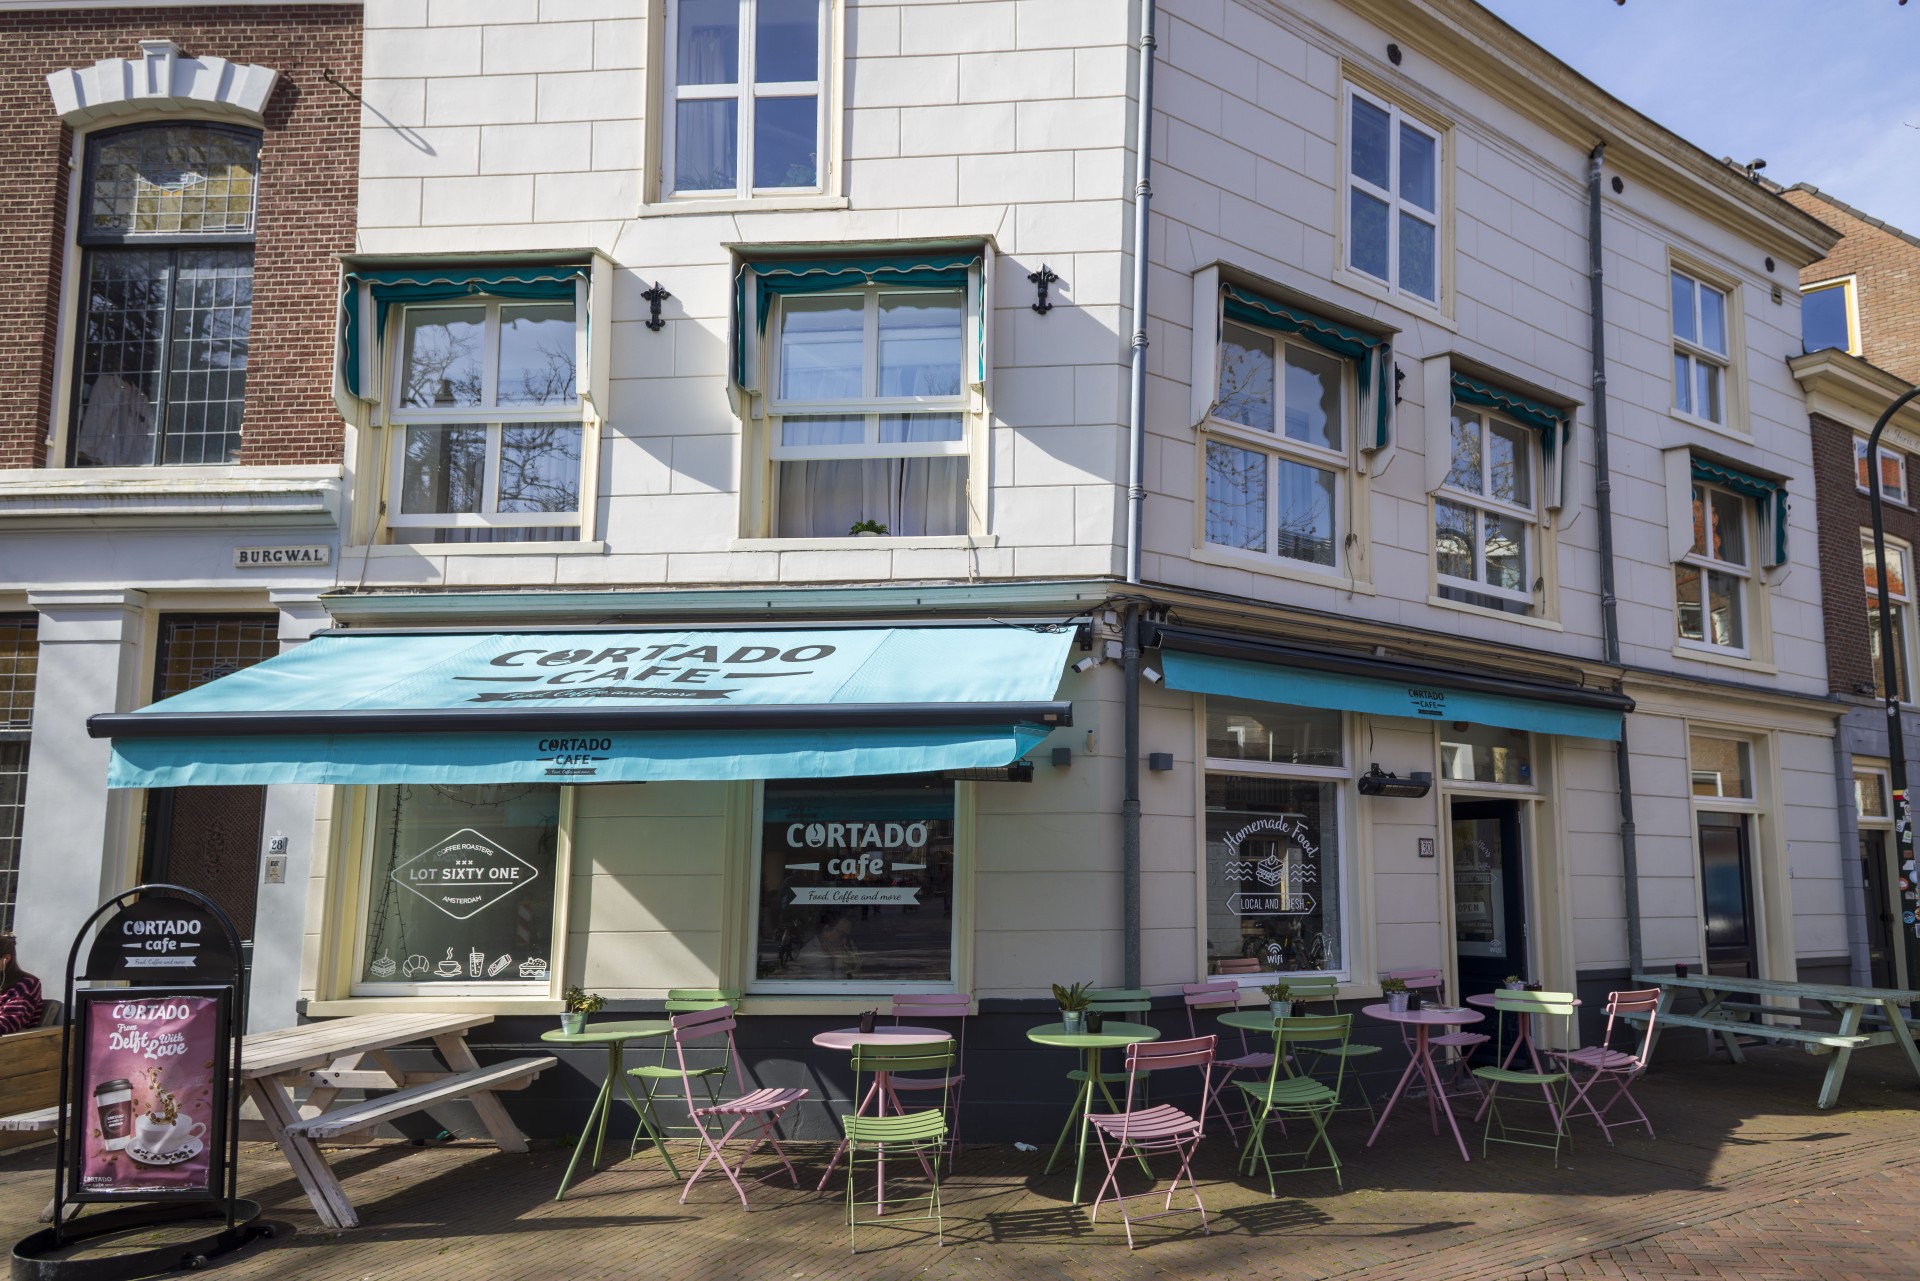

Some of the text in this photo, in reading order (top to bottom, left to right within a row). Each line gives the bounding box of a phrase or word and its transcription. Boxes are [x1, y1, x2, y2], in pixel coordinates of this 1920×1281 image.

[239, 549, 322, 562] BURGWAL
[489, 644, 836, 666] CORTADO
[546, 666, 721, 684] CAFE
[1407, 688, 1444, 701] CORTADO
[538, 738, 612, 752] CORTADO
[555, 754, 590, 765] CAFE
[786, 823, 928, 848] CORTADO
[1222, 814, 1319, 858] Homemade Food
[271, 839, 283, 850] 28
[437, 844, 461, 857] COFFEE
[461, 843, 494, 857] ROASTERS
[1422, 841, 1431, 854] 30
[409, 867, 520, 881] LOT SIXTY ONE
[827, 854, 884, 881] cafe
[442, 896, 482, 905] AMSTERDAM
[833, 890, 859, 903] Coffee
[860, 891, 880, 900] and
[1240, 898, 1263, 910] LOCAL
[1264, 898, 1279, 910] AND
[1457, 903, 1480, 913] OPEN
[122, 919, 202, 935] CORTADO
[145, 937, 177, 953] cafe
[1267, 954, 1284, 965] wifi
[112, 1004, 190, 1020] CORTADO
[117, 1023, 139, 1034] From
[109, 1030, 150, 1054] Delft
[158, 1032, 185, 1044] With
[144, 1039, 189, 1060] Love
